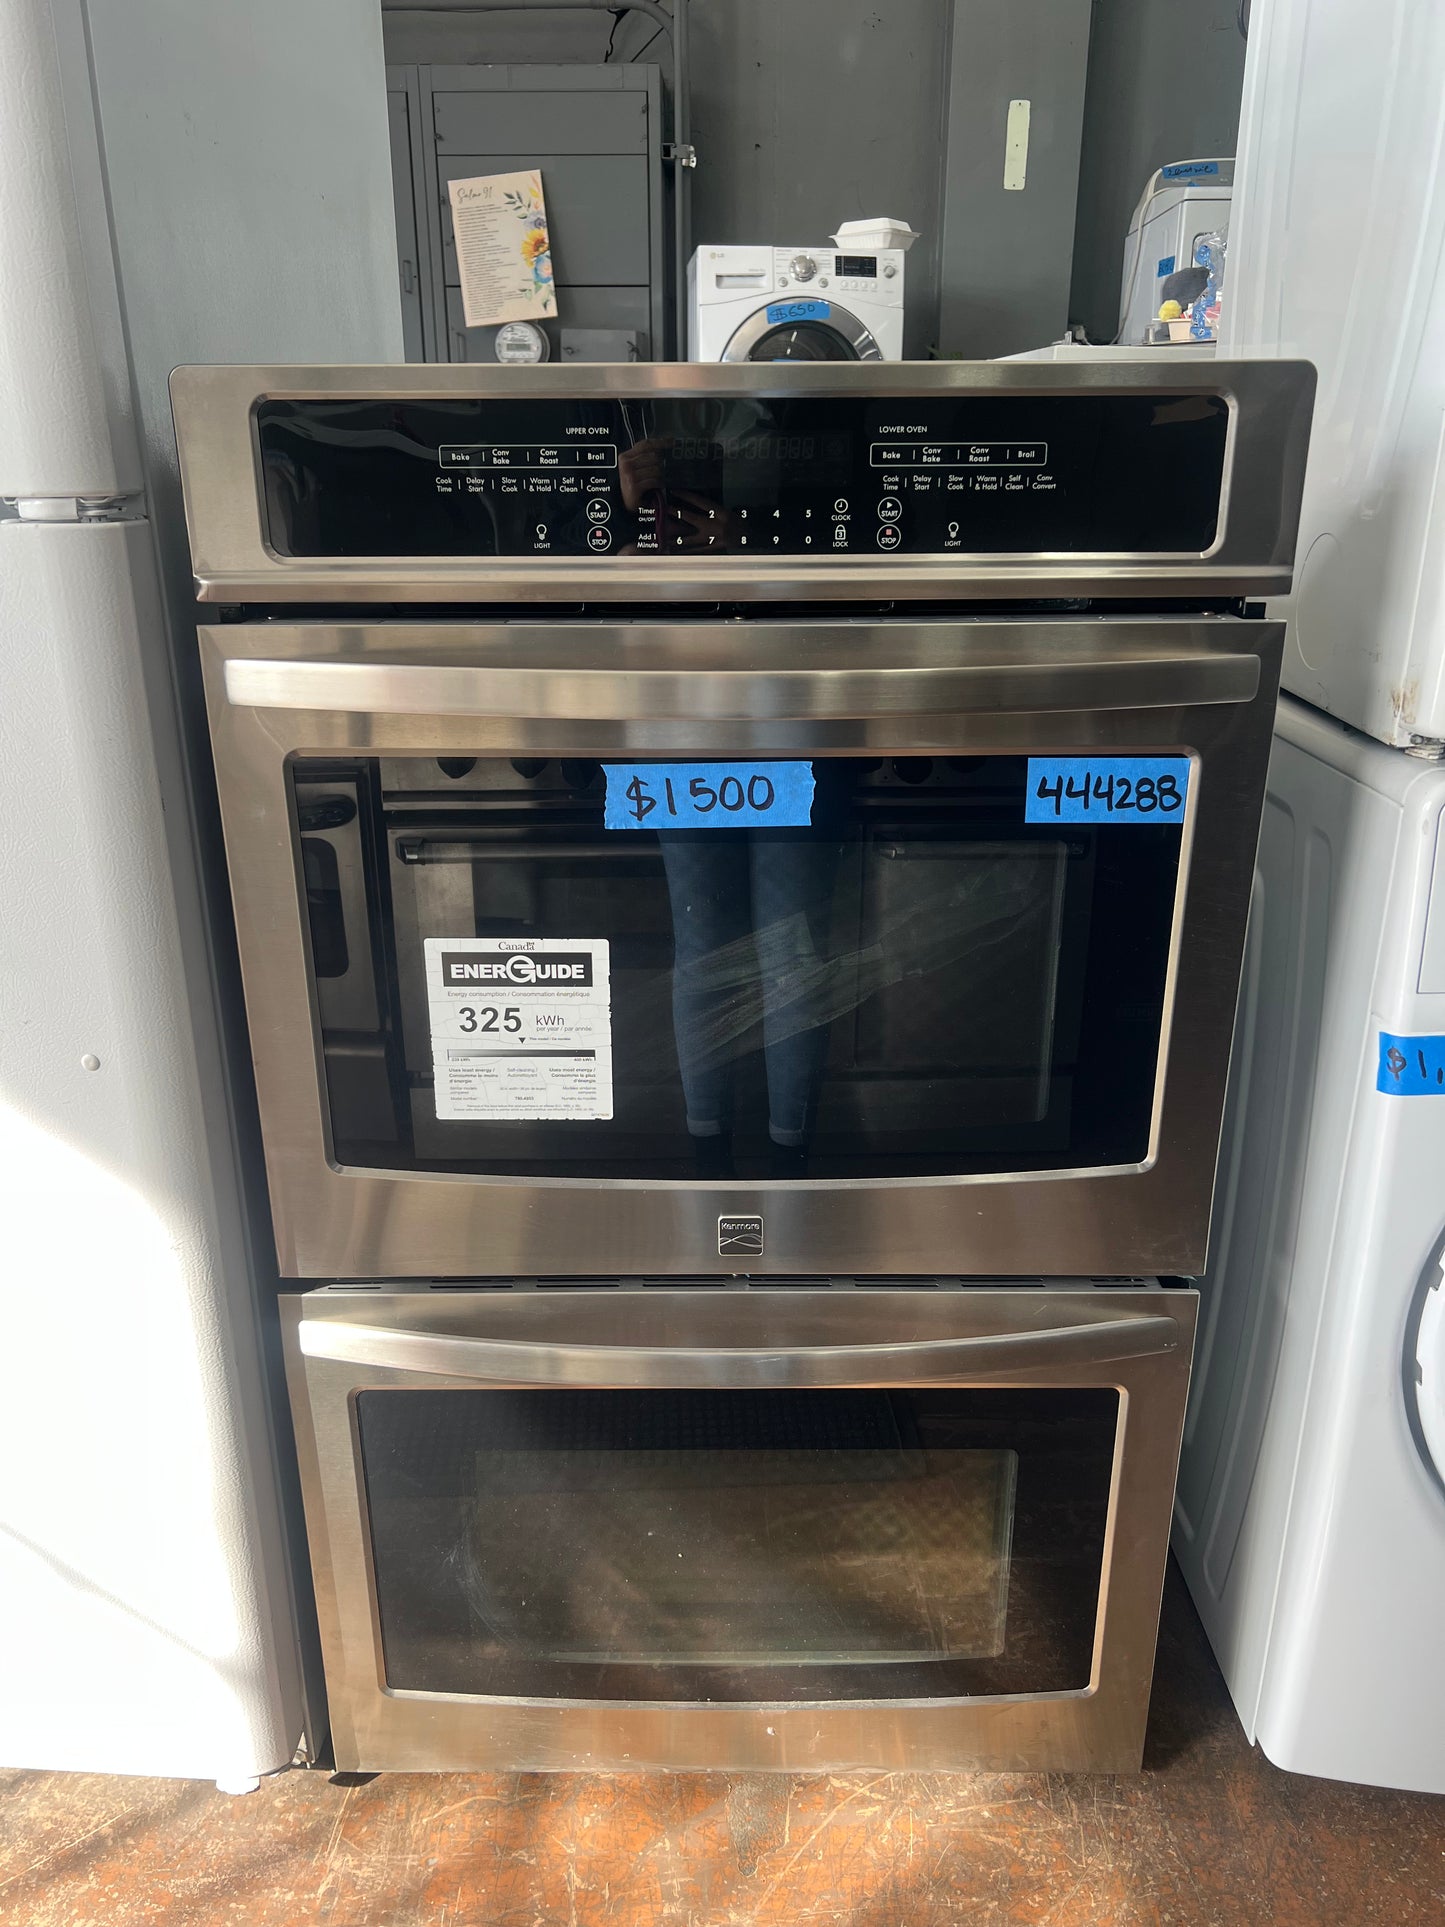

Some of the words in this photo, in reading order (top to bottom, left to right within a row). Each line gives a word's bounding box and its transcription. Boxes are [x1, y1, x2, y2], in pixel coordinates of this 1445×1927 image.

[970, 446, 989, 454] Conv
[451, 453, 470, 461] Bake
[493, 457, 510, 465] Bake
[466, 477, 484, 485] Delay
[913, 475, 931, 483] Delay
[677, 510, 681, 519] 1
[709, 510, 714, 519] 2
[741, 510, 747, 518] 3
[773, 510, 779, 518] 4
[806, 510, 811, 518] 5
[741, 536, 747, 544] 8
[773, 536, 779, 544] 9
[805, 536, 811, 544] 0
[1037, 772, 1182, 815] 444288
[626, 775, 775, 821] $1500
[498, 942, 535, 950] Canada
[450, 955, 584, 983] ENERGUIDE
[459, 1007, 522, 1032] 325
[536, 1015, 564, 1025] kWh
